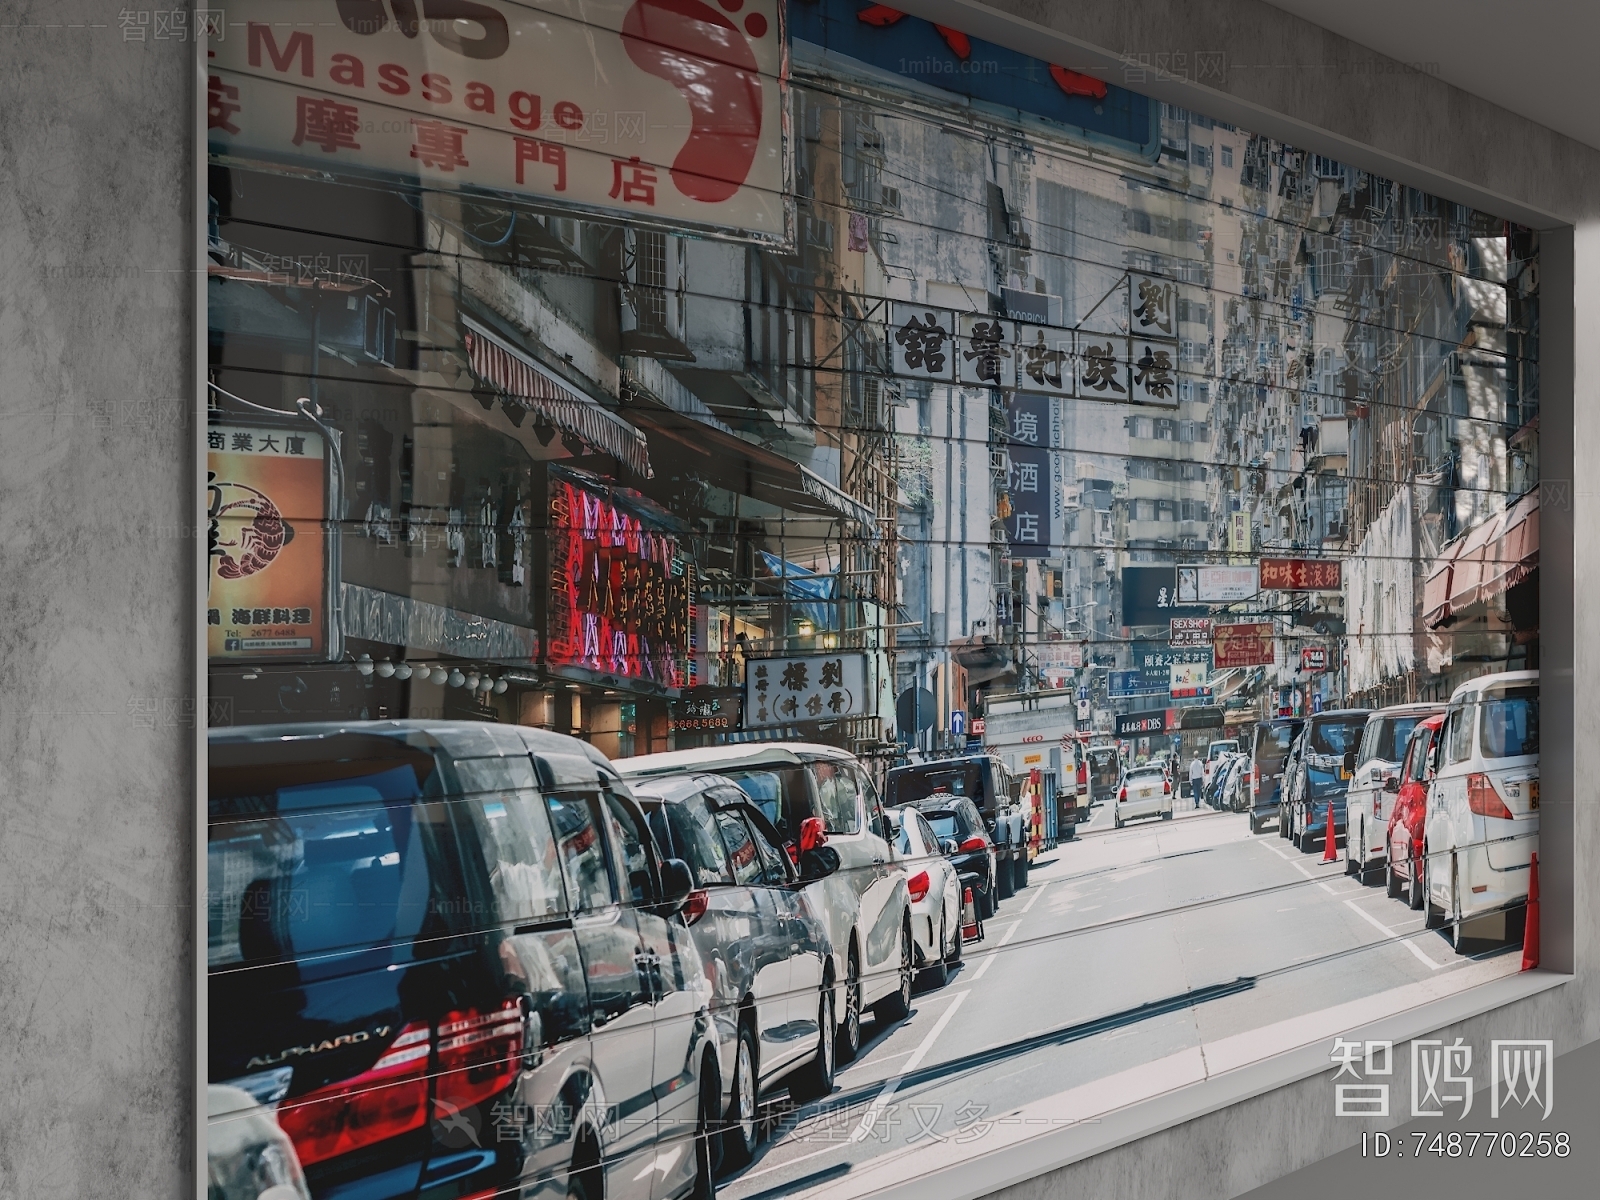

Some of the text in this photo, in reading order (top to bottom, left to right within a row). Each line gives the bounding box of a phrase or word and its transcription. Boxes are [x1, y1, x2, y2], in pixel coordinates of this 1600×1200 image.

[246, 21, 584, 131] Massage
[1007, 308, 1047, 326] OODRICH
[1262, 561, 1340, 588] 和味生滾粥
[1174, 618, 1209, 629] SEX SHOP
[225, 628, 296, 638] Tel: 2677 6488
[1147, 717, 1161, 730] DBS
[246, 1031, 370, 1069] ALPHARD
